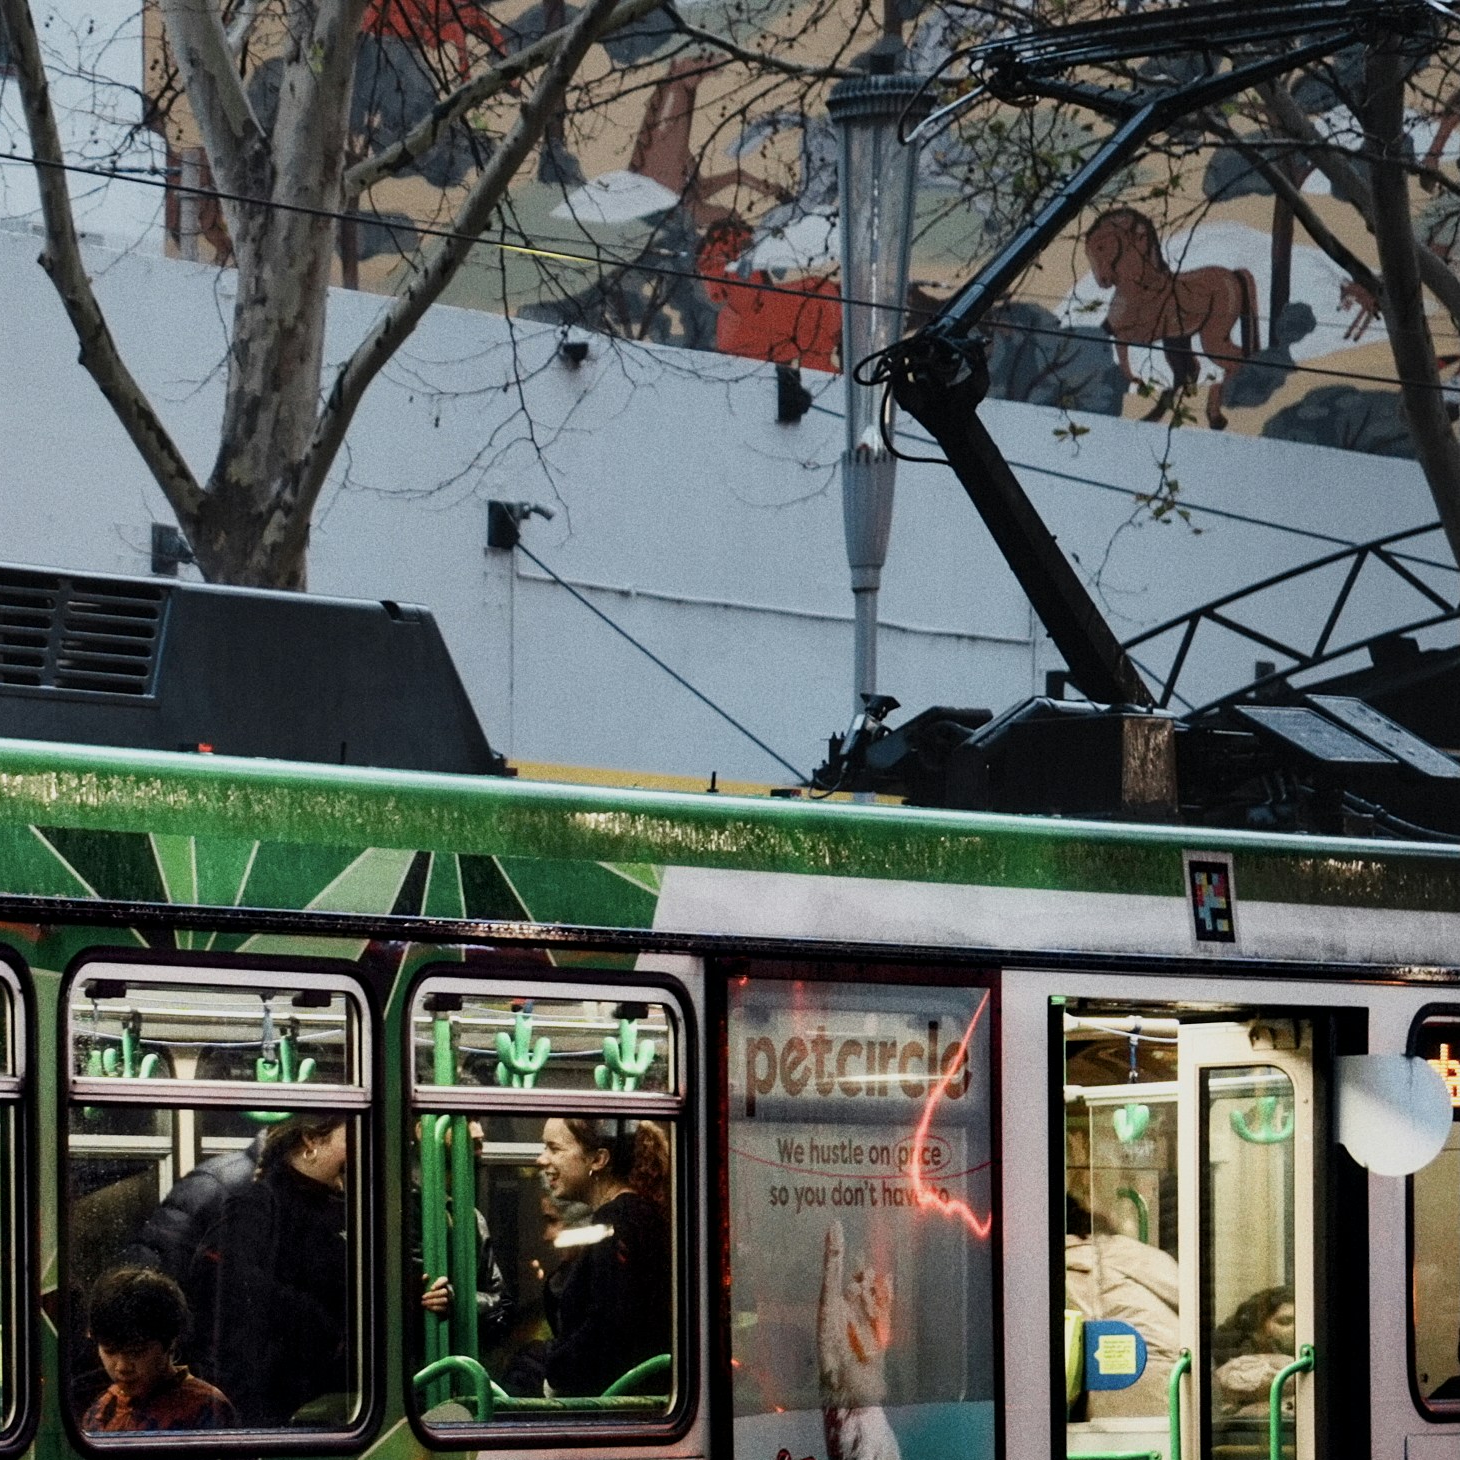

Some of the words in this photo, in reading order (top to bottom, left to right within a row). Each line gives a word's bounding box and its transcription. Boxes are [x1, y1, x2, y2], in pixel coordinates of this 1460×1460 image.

[778, 1138, 803, 1165] We
[809, 1138, 864, 1165] hustle
[869, 1145, 891, 1166] on
[898, 1145, 942, 1173] prce
[769, 1185, 788, 1206] so
[794, 1186, 828, 1214] you
[831, 1179, 878, 1207] don't
[882, 1179, 924, 1207] hav
